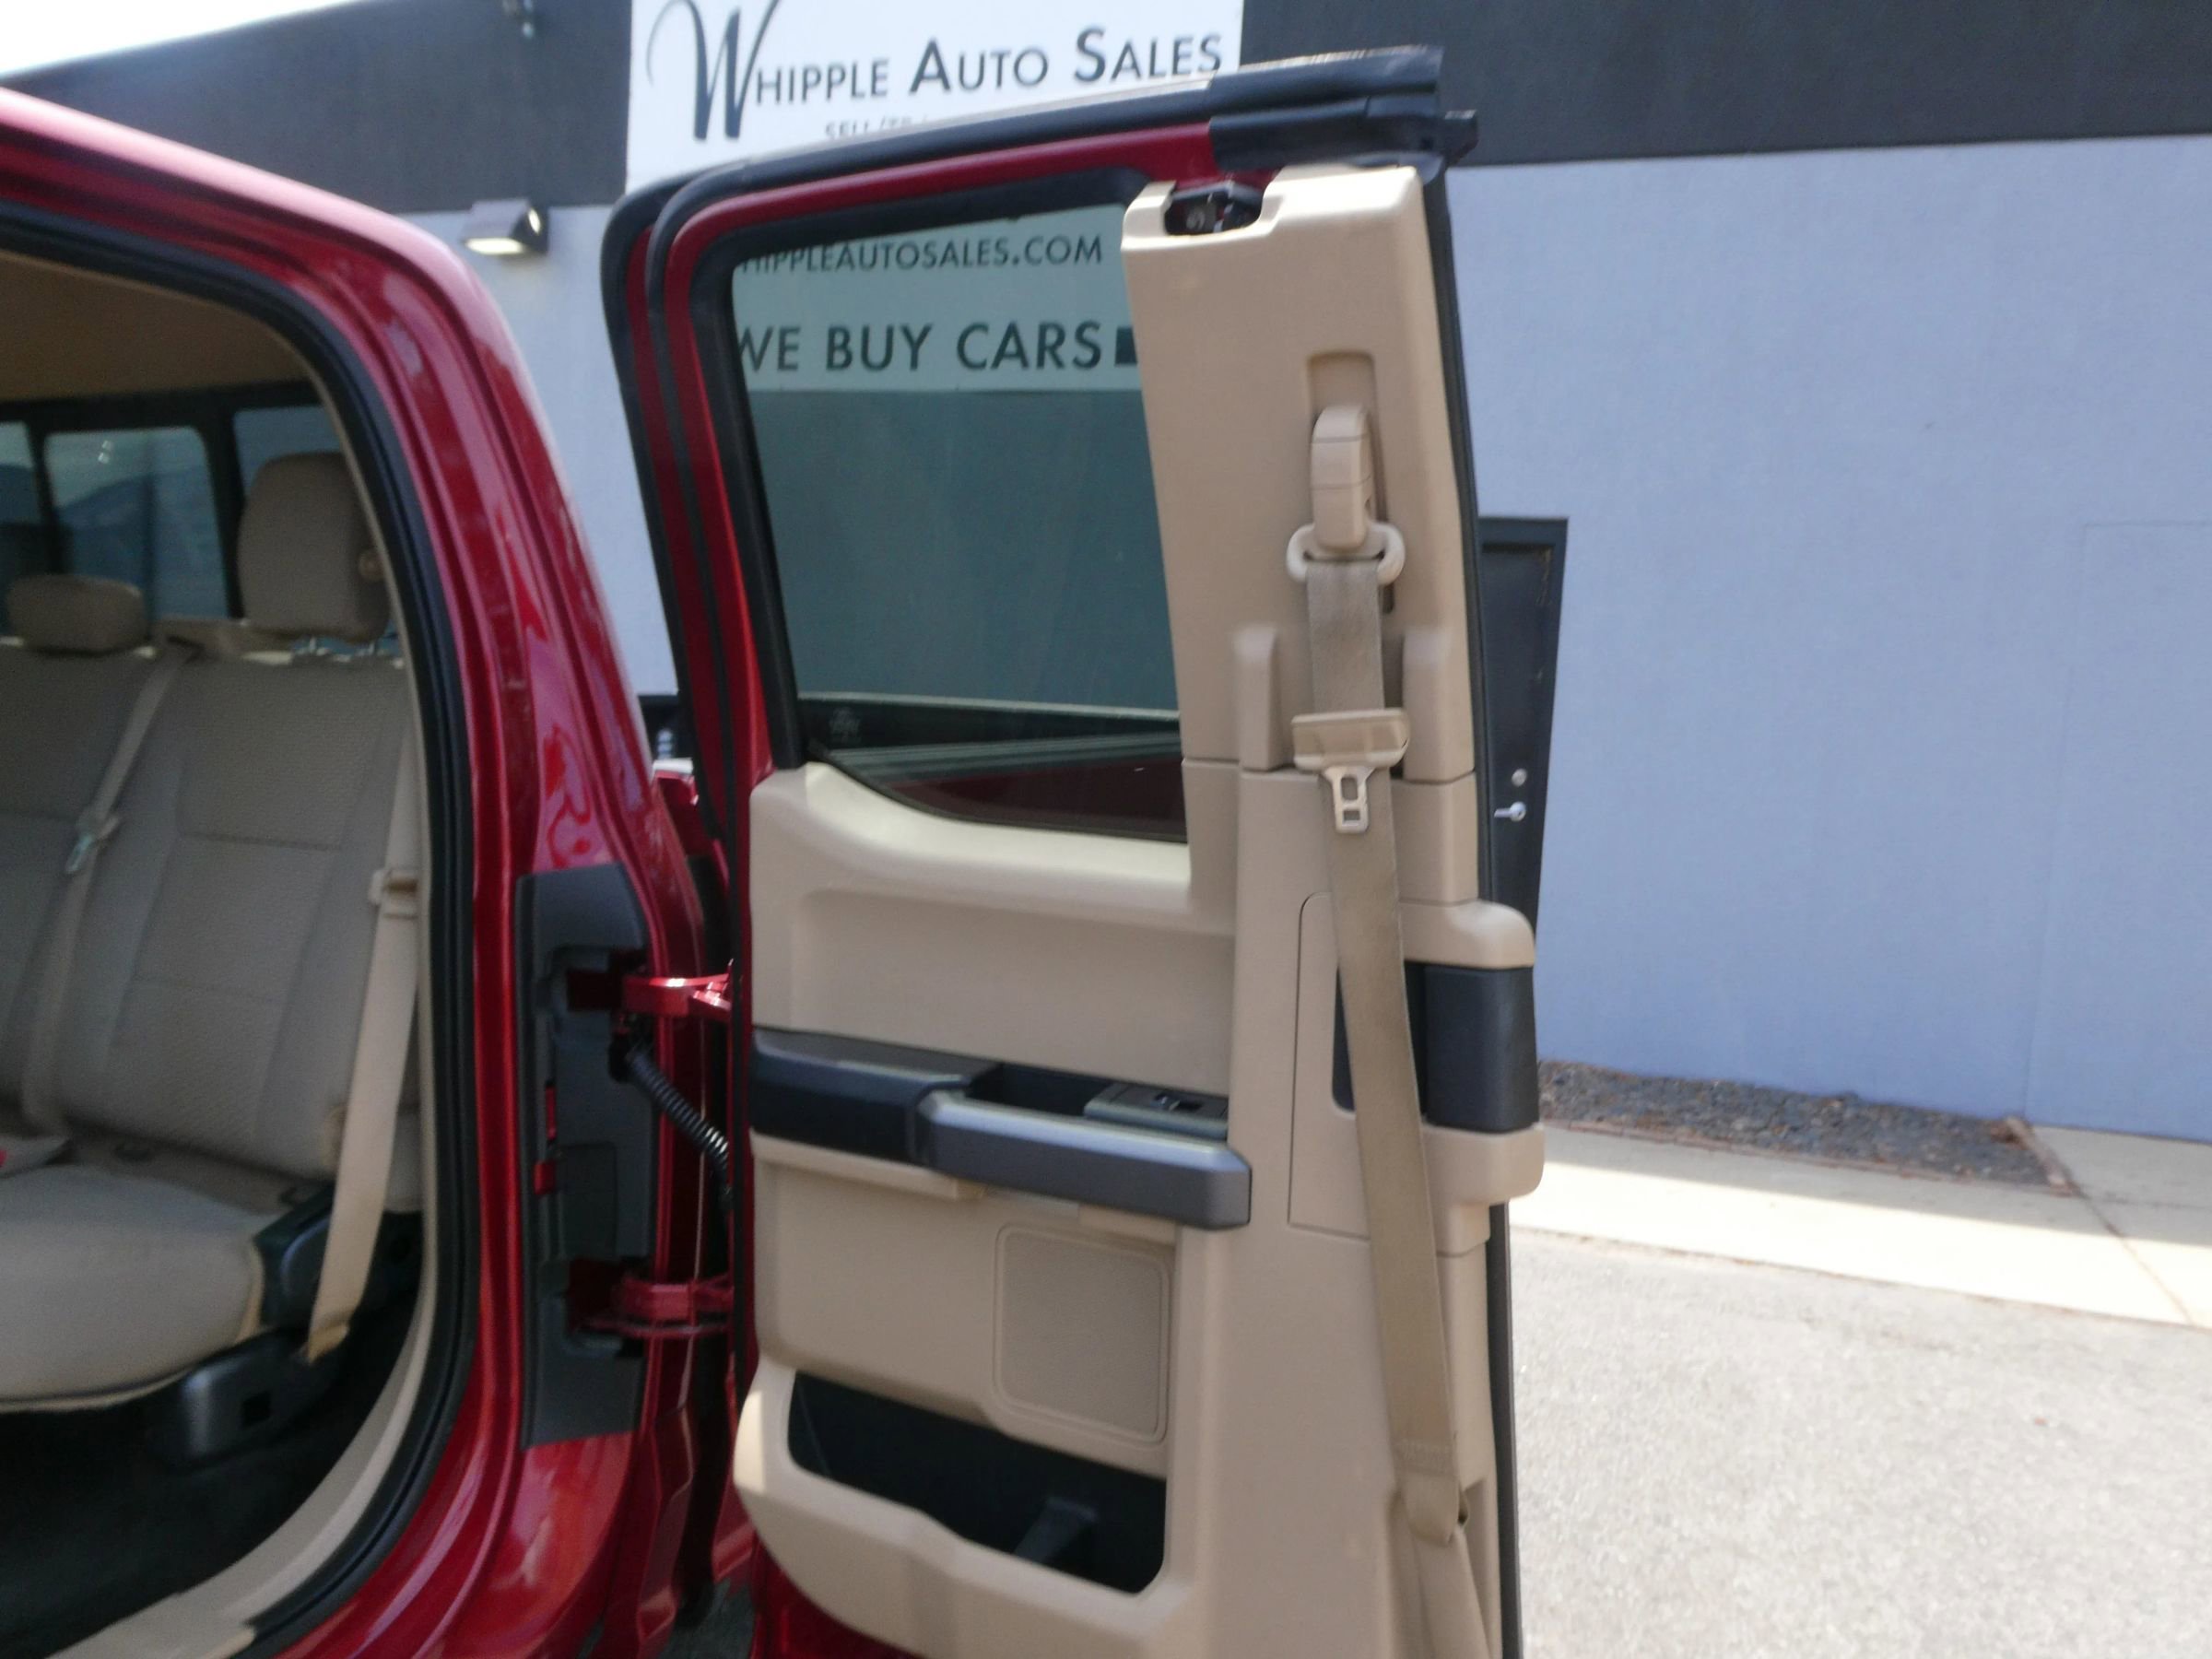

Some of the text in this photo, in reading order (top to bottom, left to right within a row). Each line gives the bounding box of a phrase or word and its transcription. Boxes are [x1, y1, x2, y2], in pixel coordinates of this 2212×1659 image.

[646, 0, 1222, 140] WHIPPLE AUTO SALES
[738, 321, 1102, 371] WE BUY CARS
